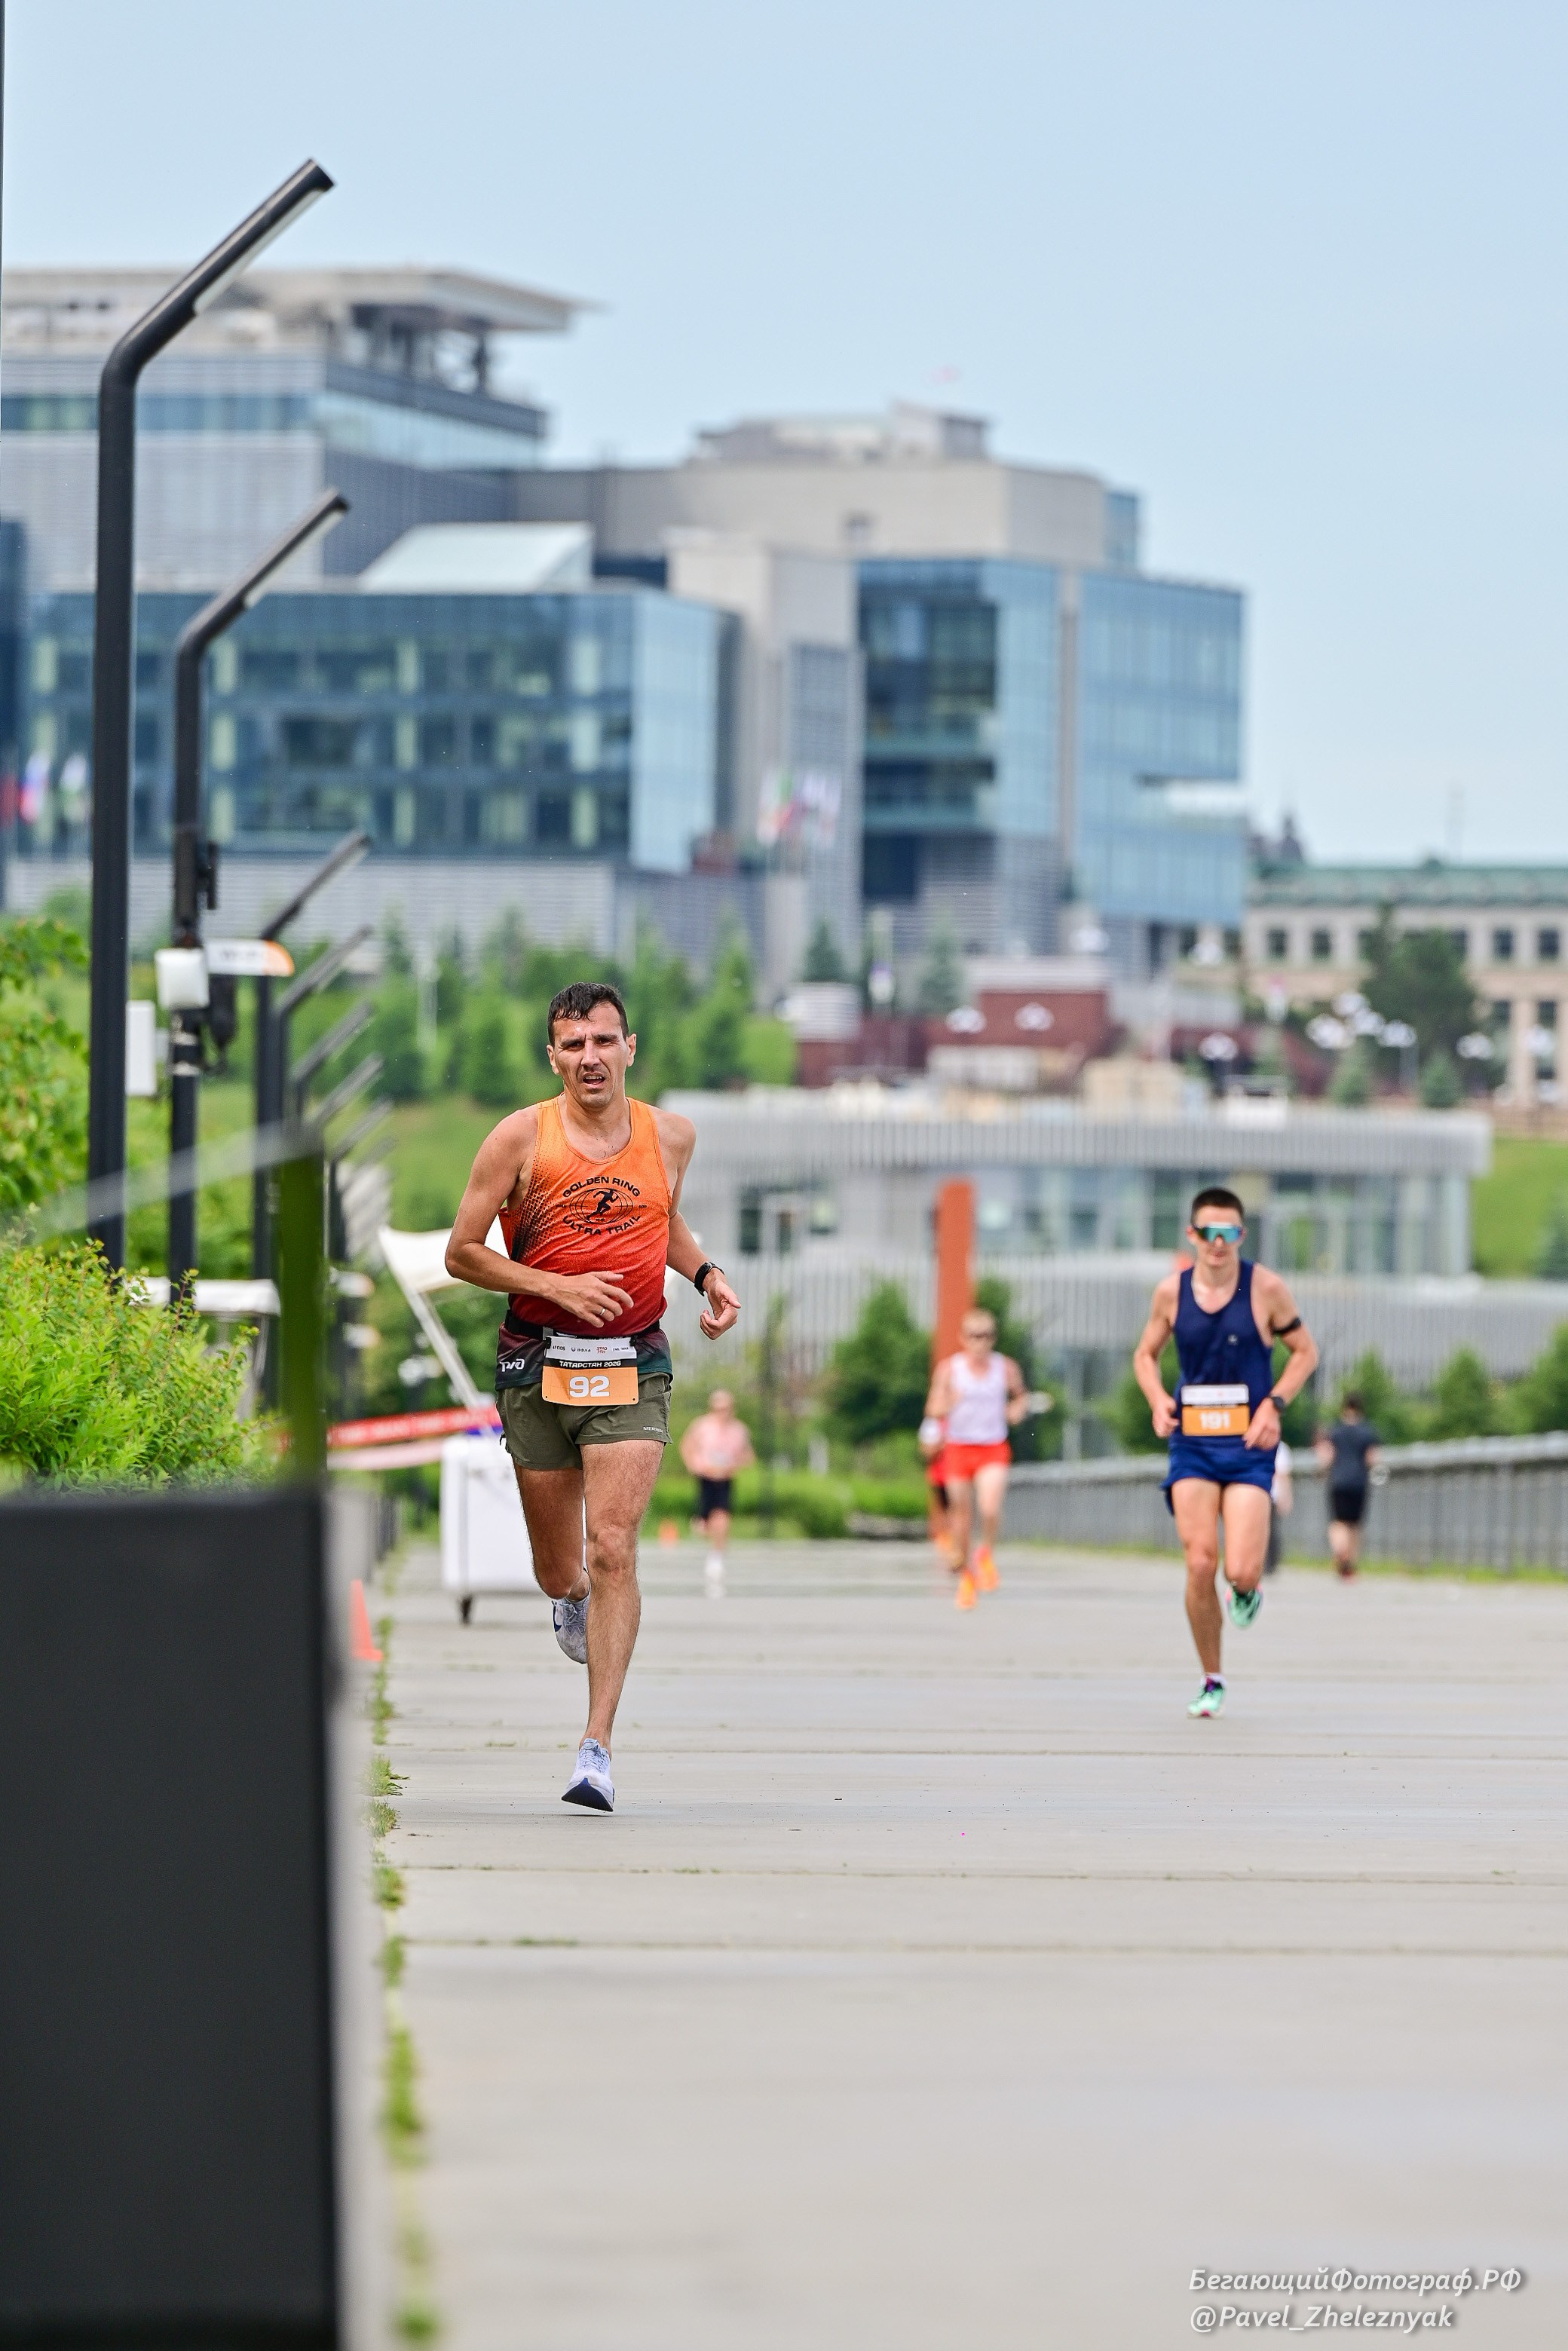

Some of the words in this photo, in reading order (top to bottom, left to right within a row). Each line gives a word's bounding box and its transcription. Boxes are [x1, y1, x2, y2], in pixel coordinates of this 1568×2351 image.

[562, 1177, 609, 1198] GOLDEN
[612, 1177, 641, 1197] RING
[563, 1215, 602, 1235] ULTRA
[606, 1215, 641, 1234] TRAIL
[569, 1376, 610, 1398] 92
[1200, 1411, 1230, 1429] 191
